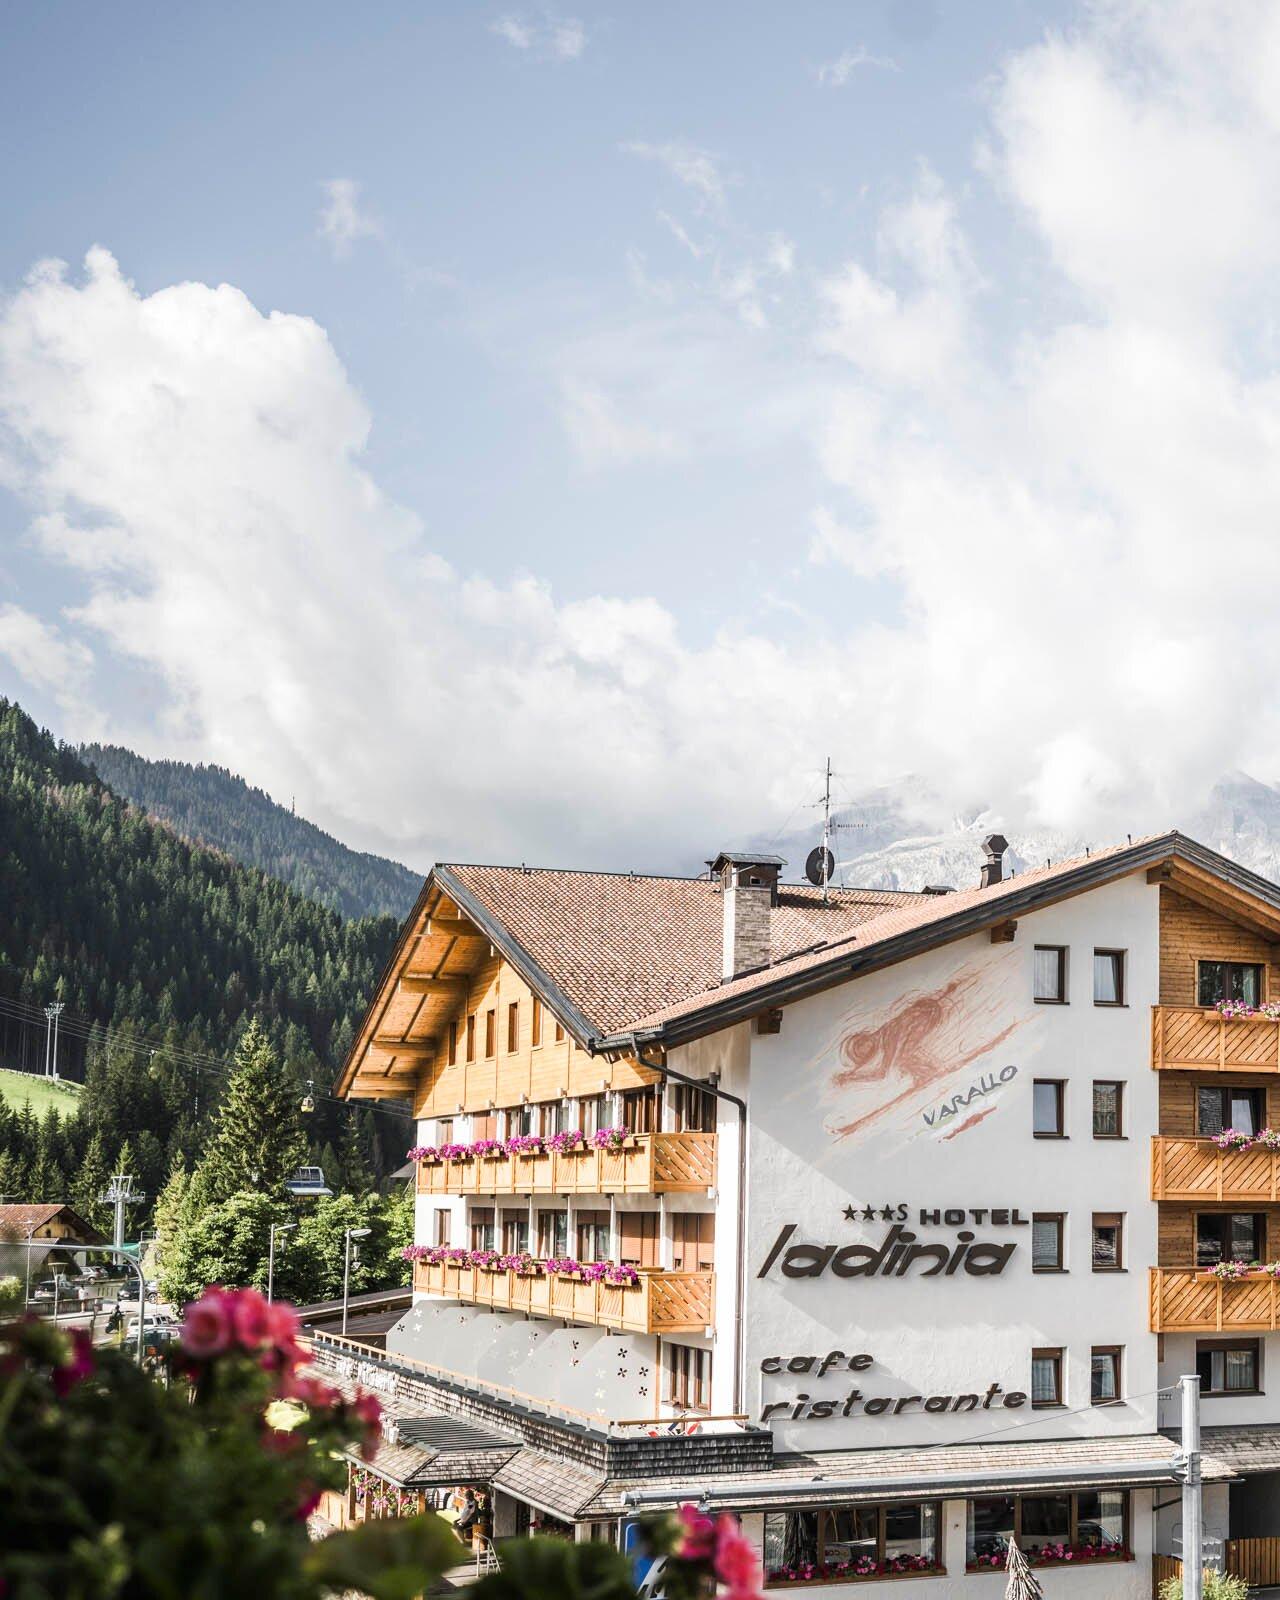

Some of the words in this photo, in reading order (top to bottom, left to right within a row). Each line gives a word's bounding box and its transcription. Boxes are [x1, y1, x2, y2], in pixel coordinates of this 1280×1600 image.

[922, 1065, 1018, 1126] VARALLO
[919, 1208, 1029, 1225] HOTEL
[760, 1350, 874, 1378] cafe
[760, 1382, 1027, 1423] ristorante
